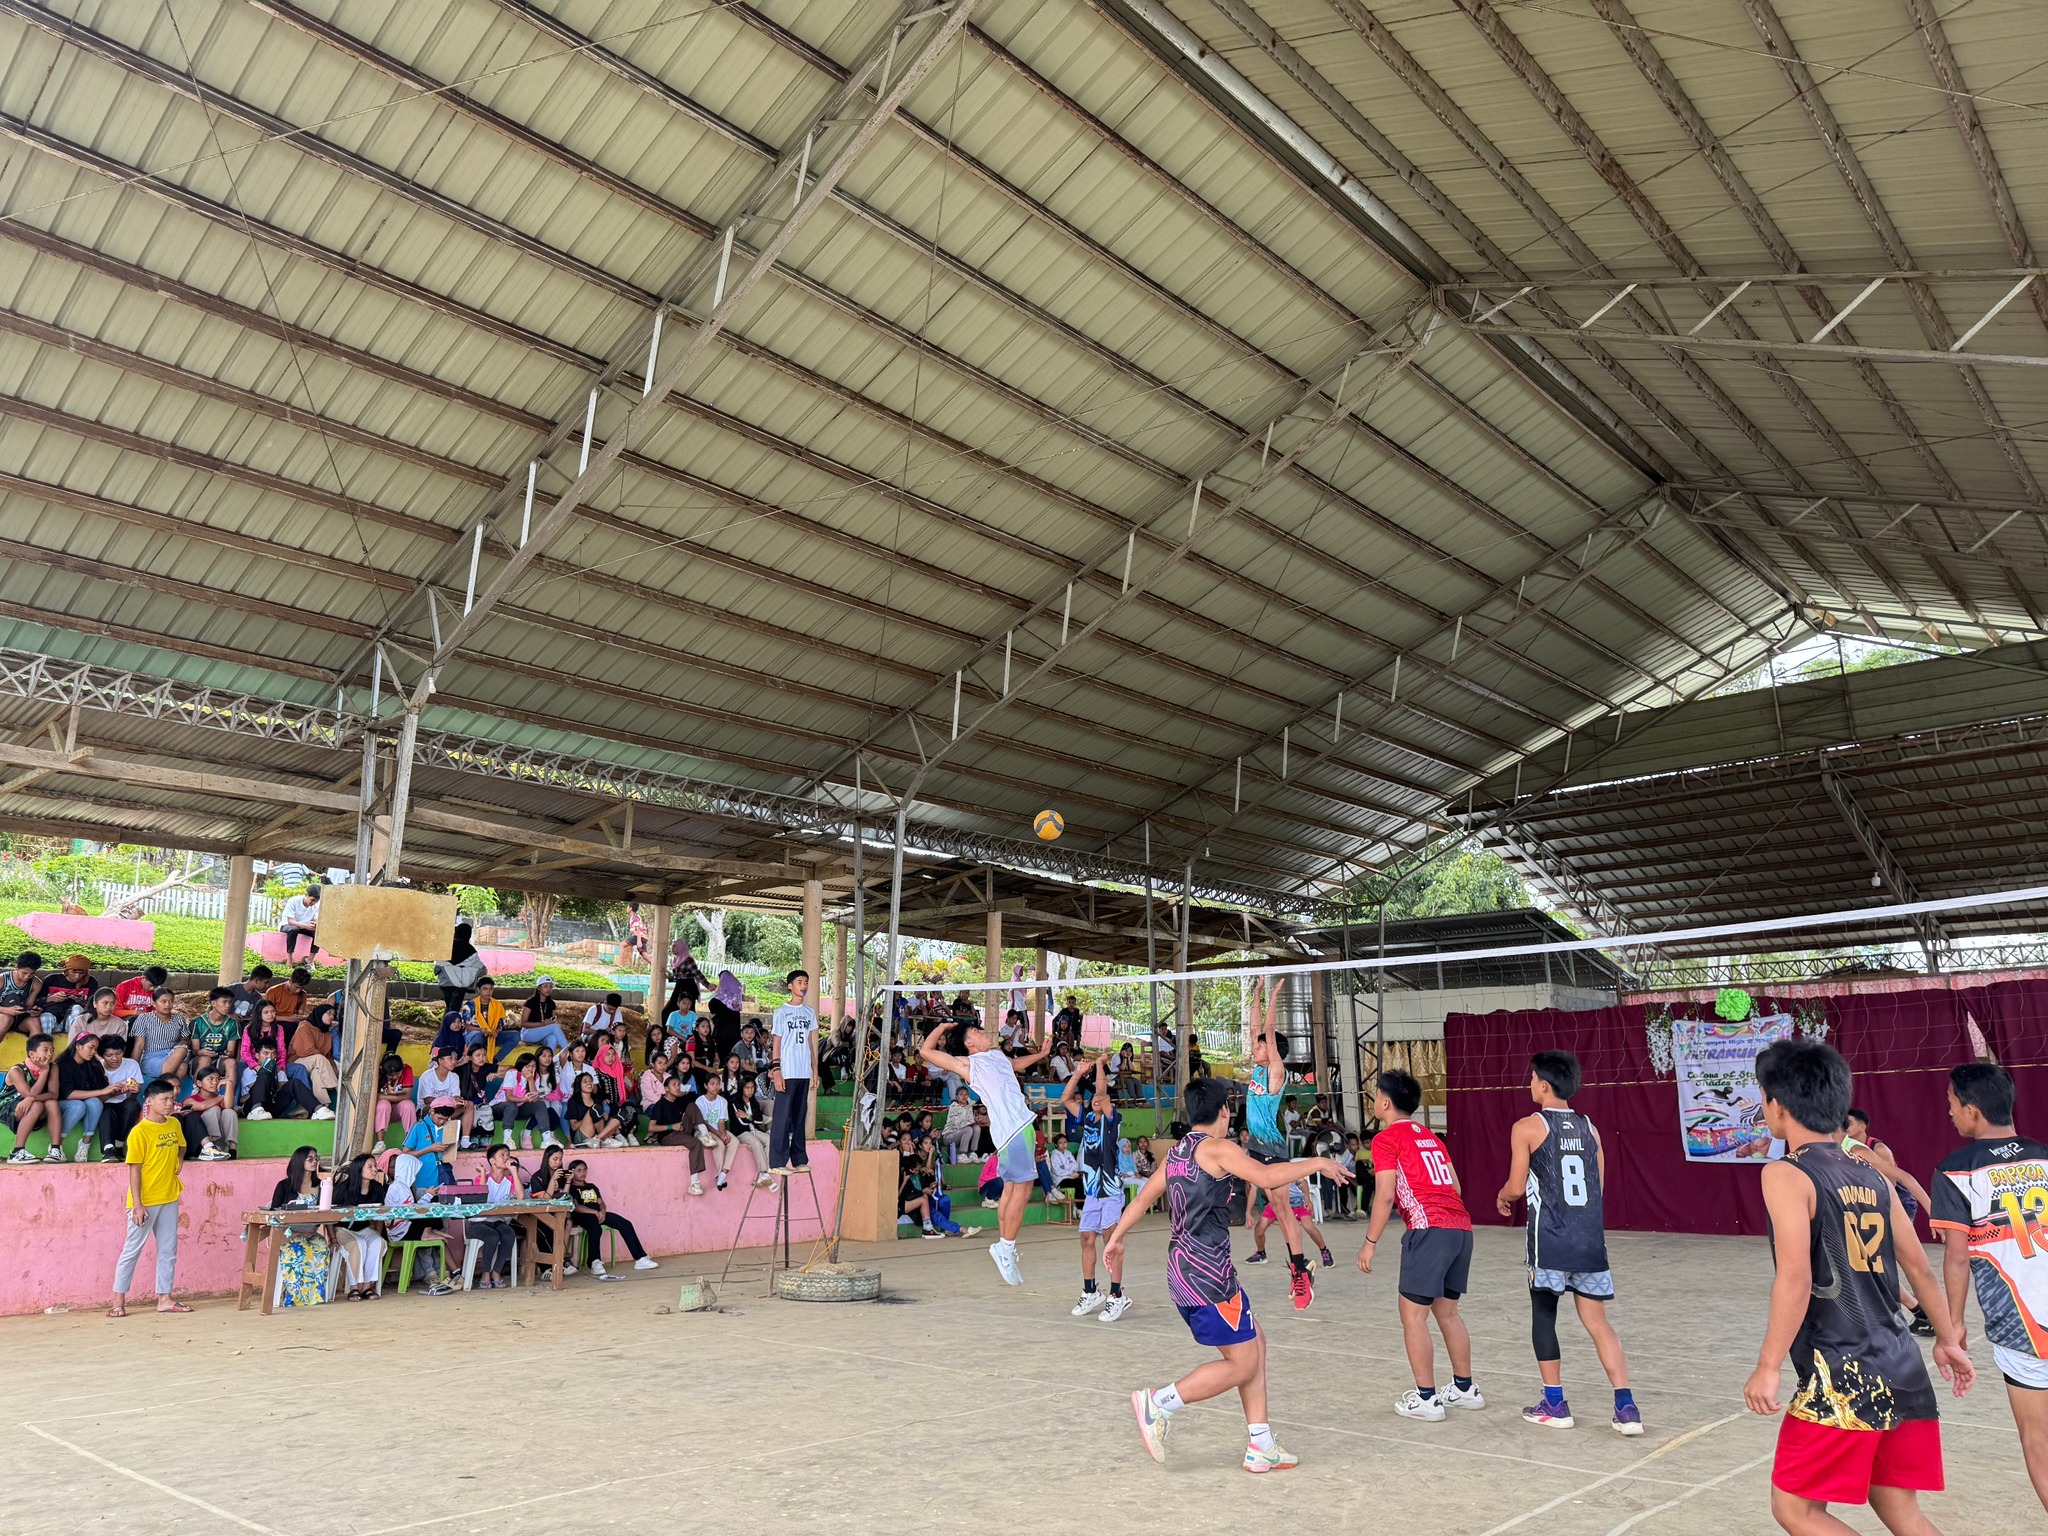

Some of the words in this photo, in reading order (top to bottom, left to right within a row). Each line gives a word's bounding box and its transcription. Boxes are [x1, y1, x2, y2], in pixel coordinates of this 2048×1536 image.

[796, 1031, 804, 1044] 15
[158, 1131, 177, 1141] GUCCI
[1560, 1138, 1585, 1151] JAWIL
[1421, 1151, 1453, 1185] 06
[1561, 1154, 1588, 1206] 8
[1844, 1212, 1885, 1273] 02
